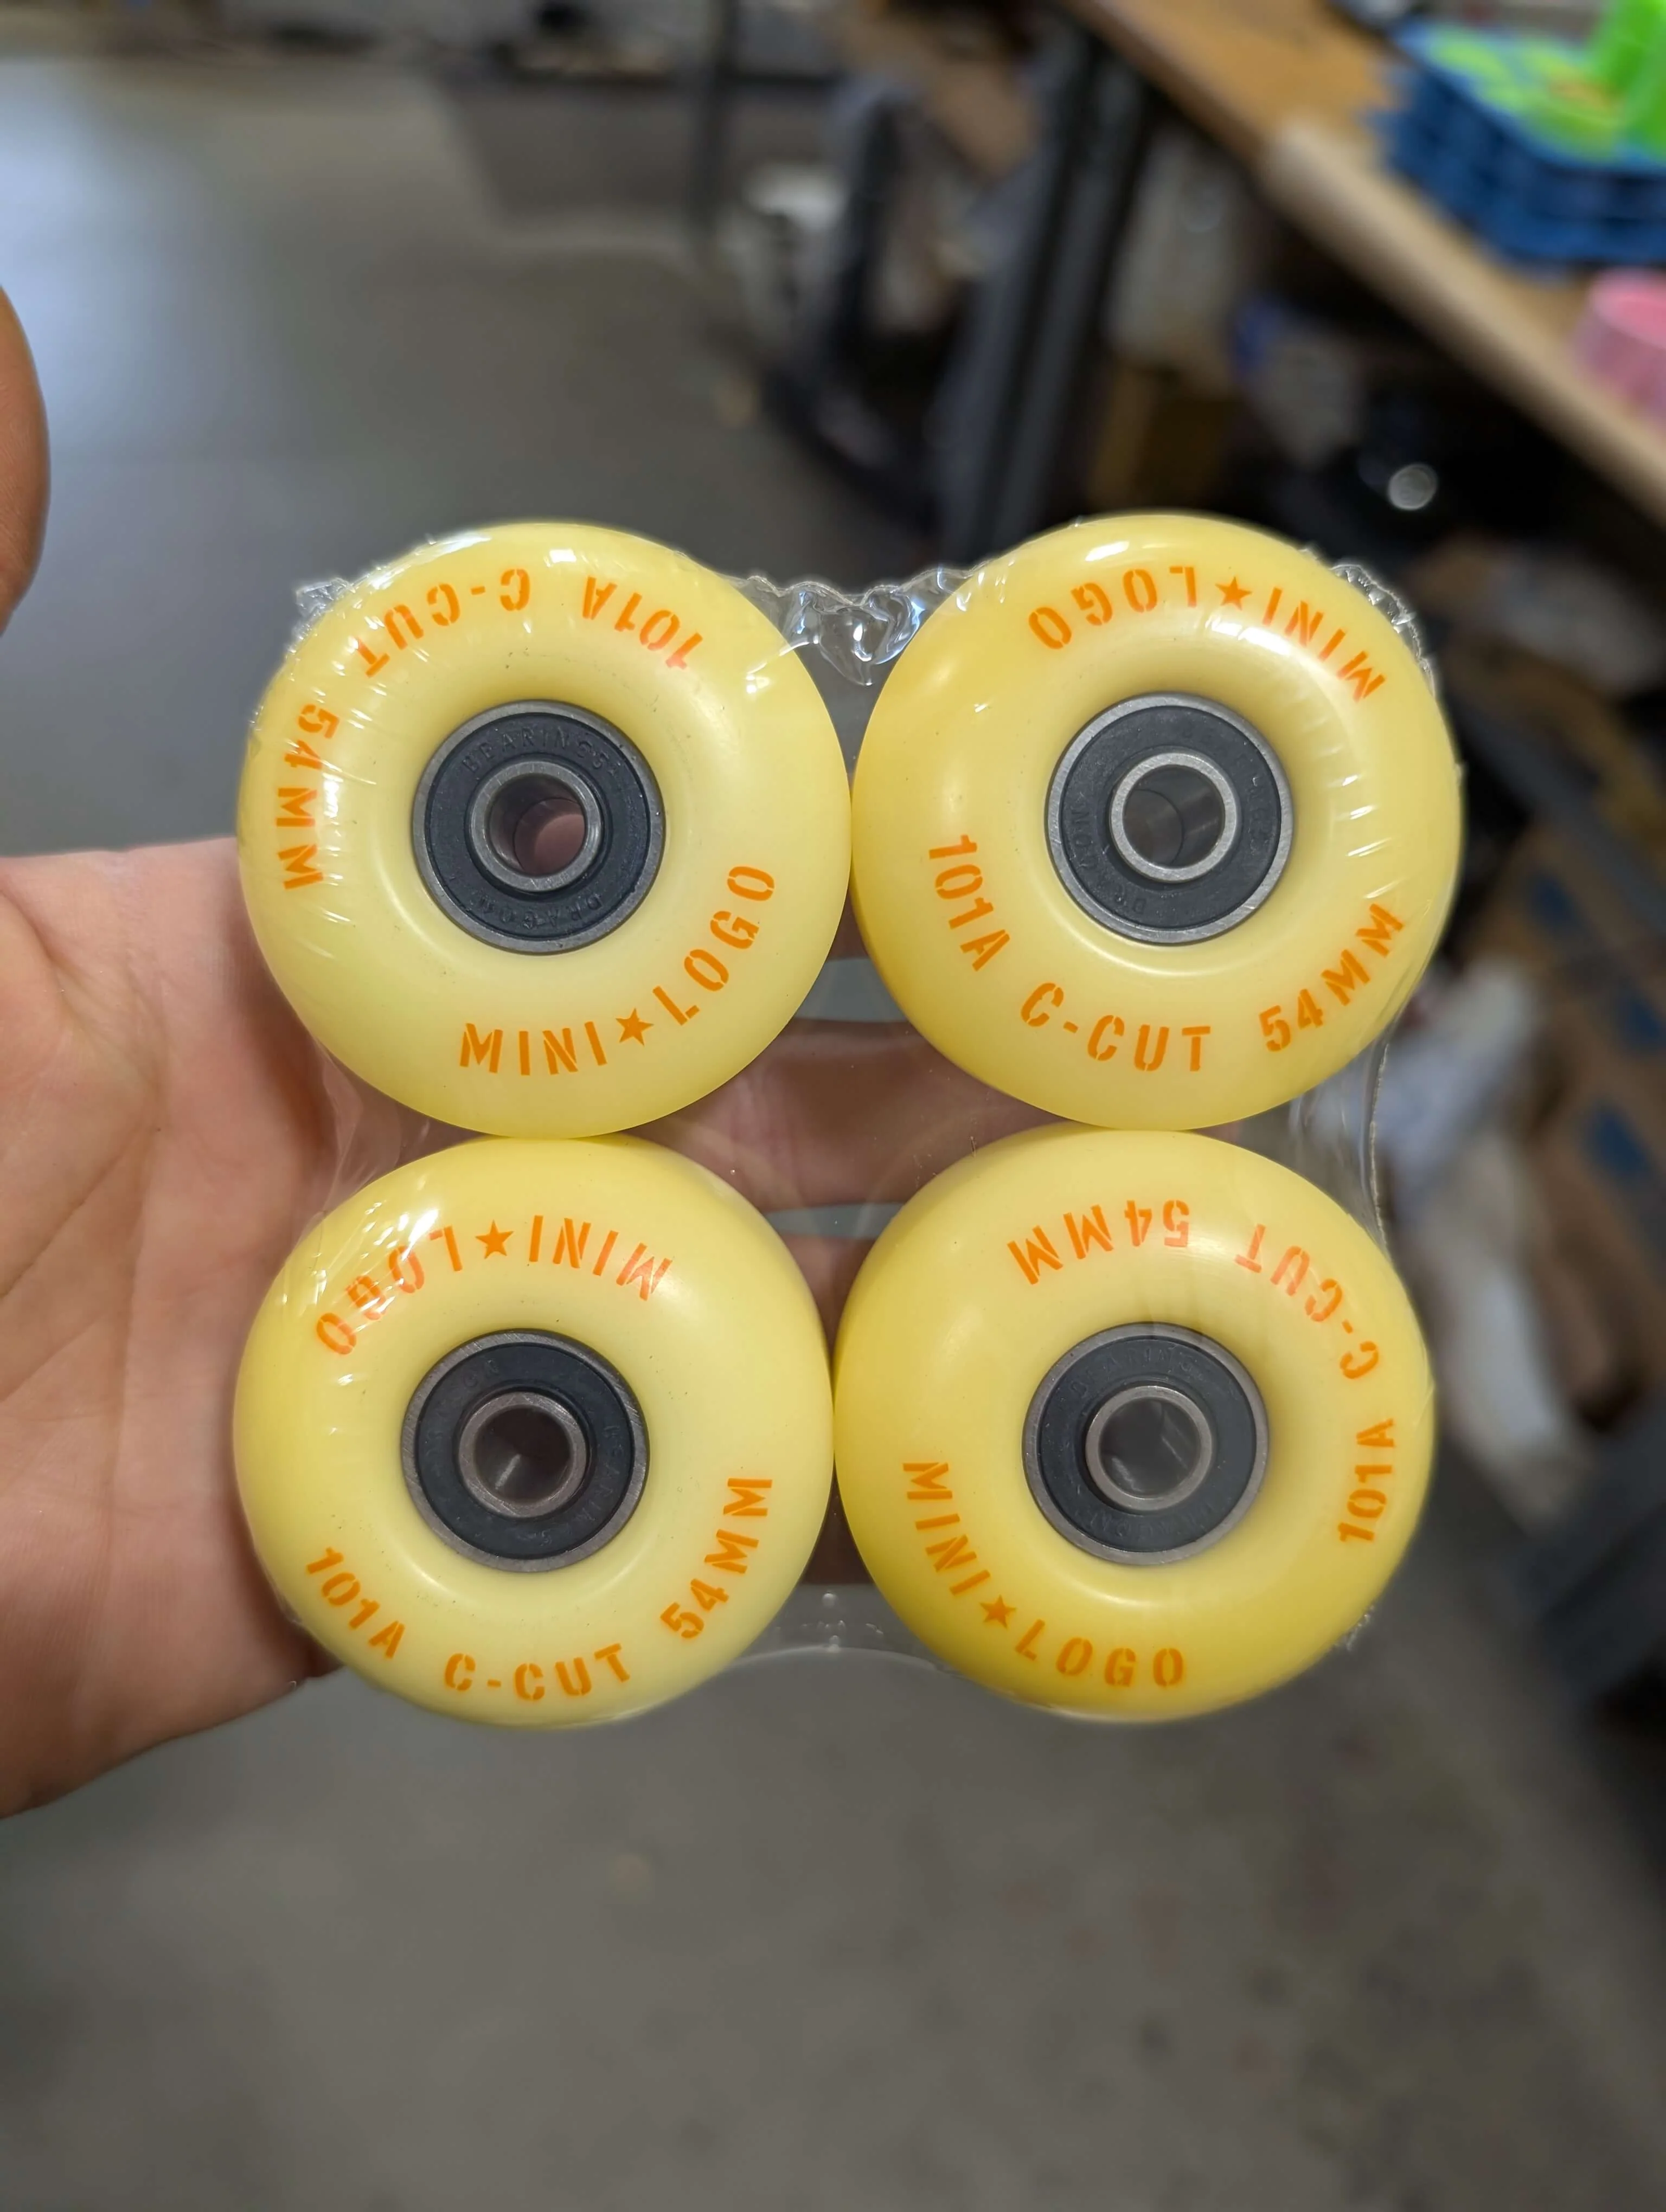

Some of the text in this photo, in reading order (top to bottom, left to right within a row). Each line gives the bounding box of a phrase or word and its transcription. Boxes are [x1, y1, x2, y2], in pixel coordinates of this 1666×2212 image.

[273, 567, 704, 891] 101A C-CUT 54MM
[1026, 564, 1386, 704] MINI LOGO
[457, 863, 777, 1076] MINI LOGO
[928, 832, 1011, 972] 101A
[1019, 980, 1213, 1074] C-CUT
[1256, 901, 1406, 1053] 54MM
[314, 1213, 672, 1358] MINI LOGO
[1006, 1198, 1396, 1545] 101A C-CUT 54MM
[305, 1546, 407, 1660] 101A
[443, 1642, 632, 1703] C-CUT
[658, 1476, 774, 1642] 54MM
[902, 1459, 1186, 1689] MINI LOGO
